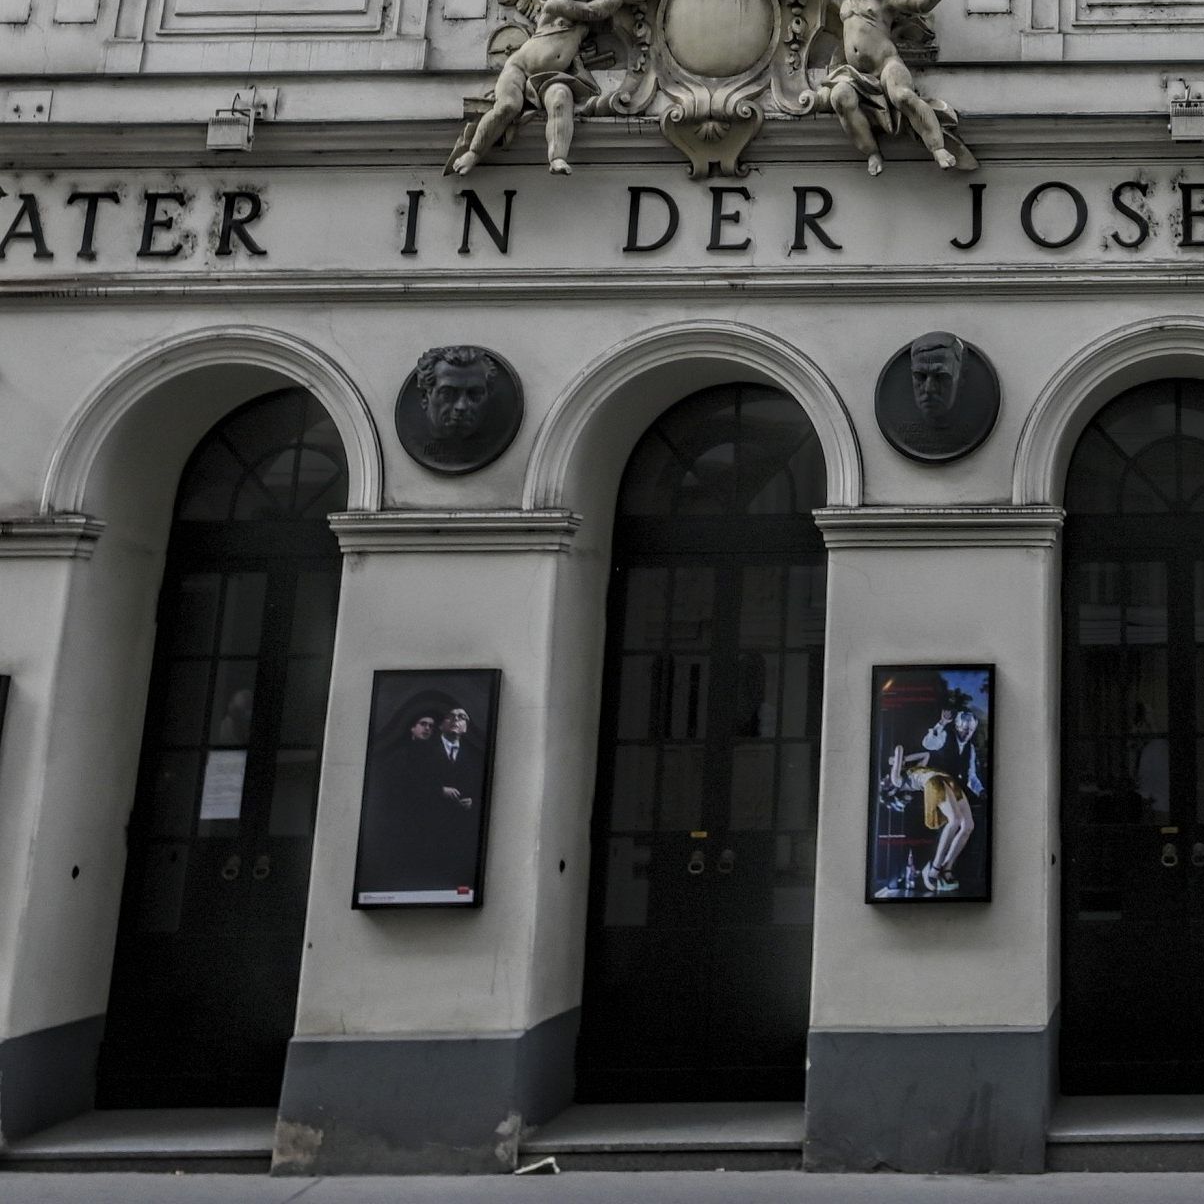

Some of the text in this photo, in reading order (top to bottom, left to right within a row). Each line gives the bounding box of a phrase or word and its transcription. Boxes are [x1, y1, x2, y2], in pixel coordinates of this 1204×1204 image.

[0, 186, 268, 260] ATER
[401, 189, 517, 255] IN
[623, 184, 843, 252] DER
